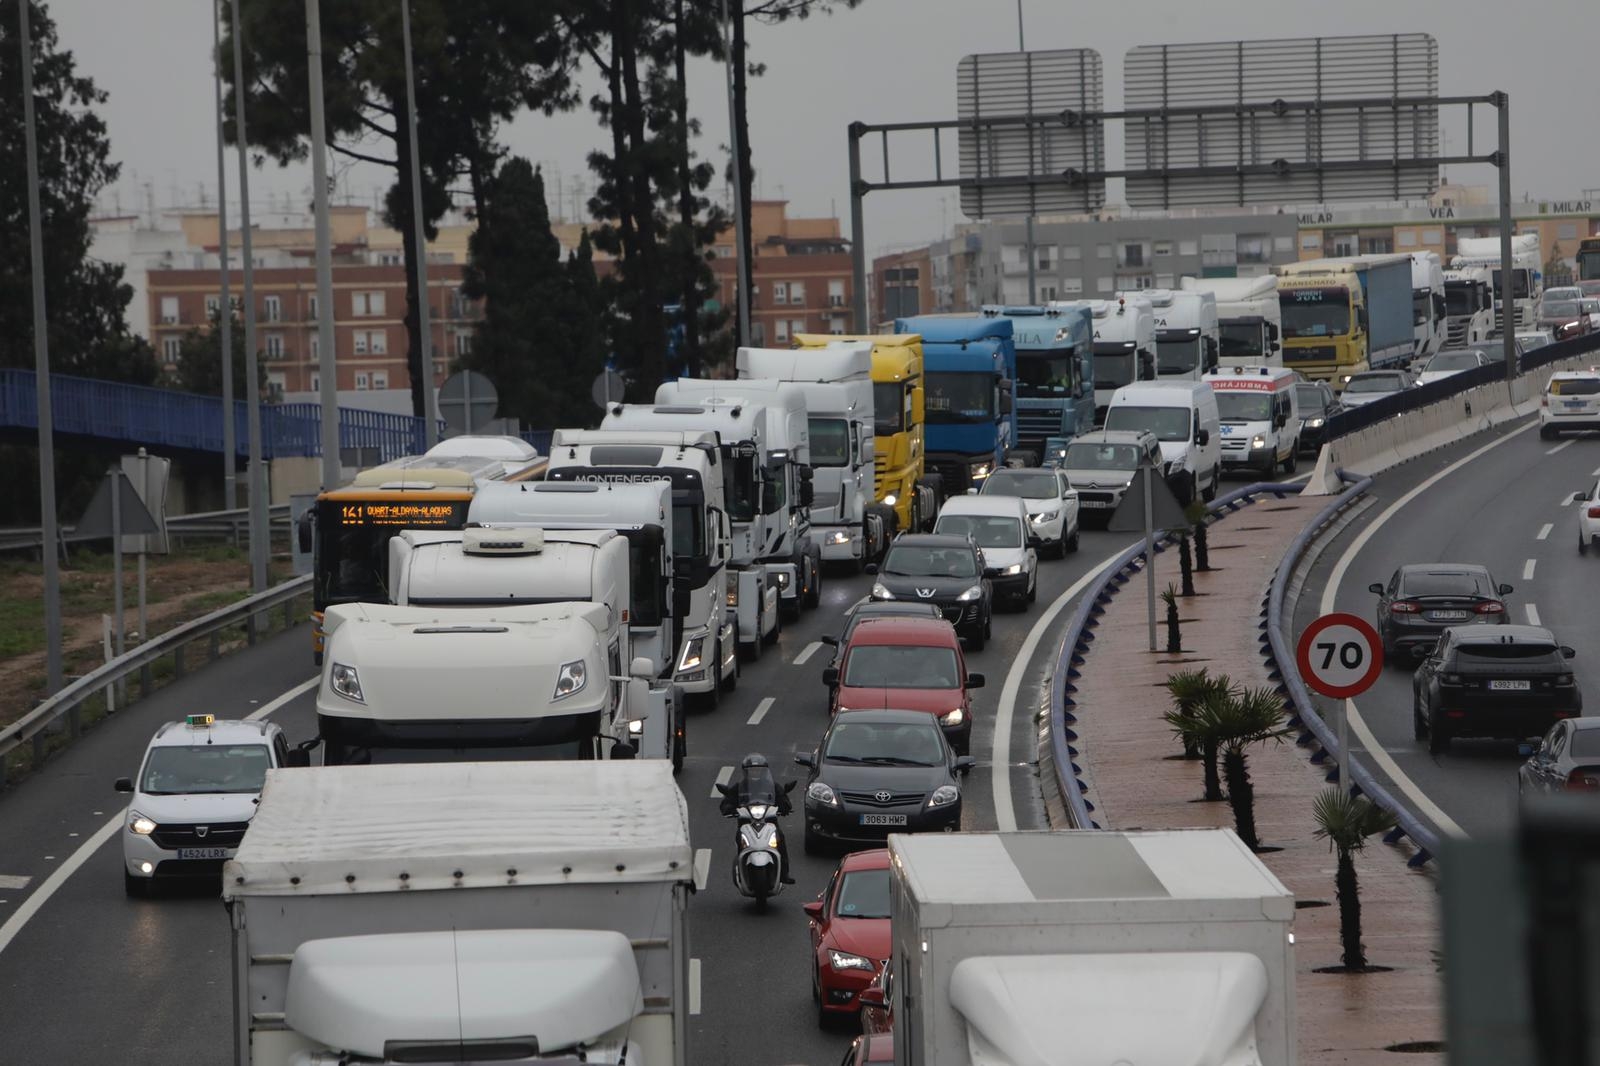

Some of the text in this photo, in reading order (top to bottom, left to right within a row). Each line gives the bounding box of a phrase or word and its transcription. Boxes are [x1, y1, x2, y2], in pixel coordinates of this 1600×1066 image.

[1553, 201, 1591, 213] MILAR
[1429, 208, 1454, 218] VEA
[1297, 213, 1333, 224] MILAR
[575, 474, 673, 484] MONTENEGRO
[342, 506, 364, 525] 161
[1316, 641, 1364, 670] 70
[865, 815, 905, 824] 3063 HMP
[183, 848, 226, 858] 4524 LRX
